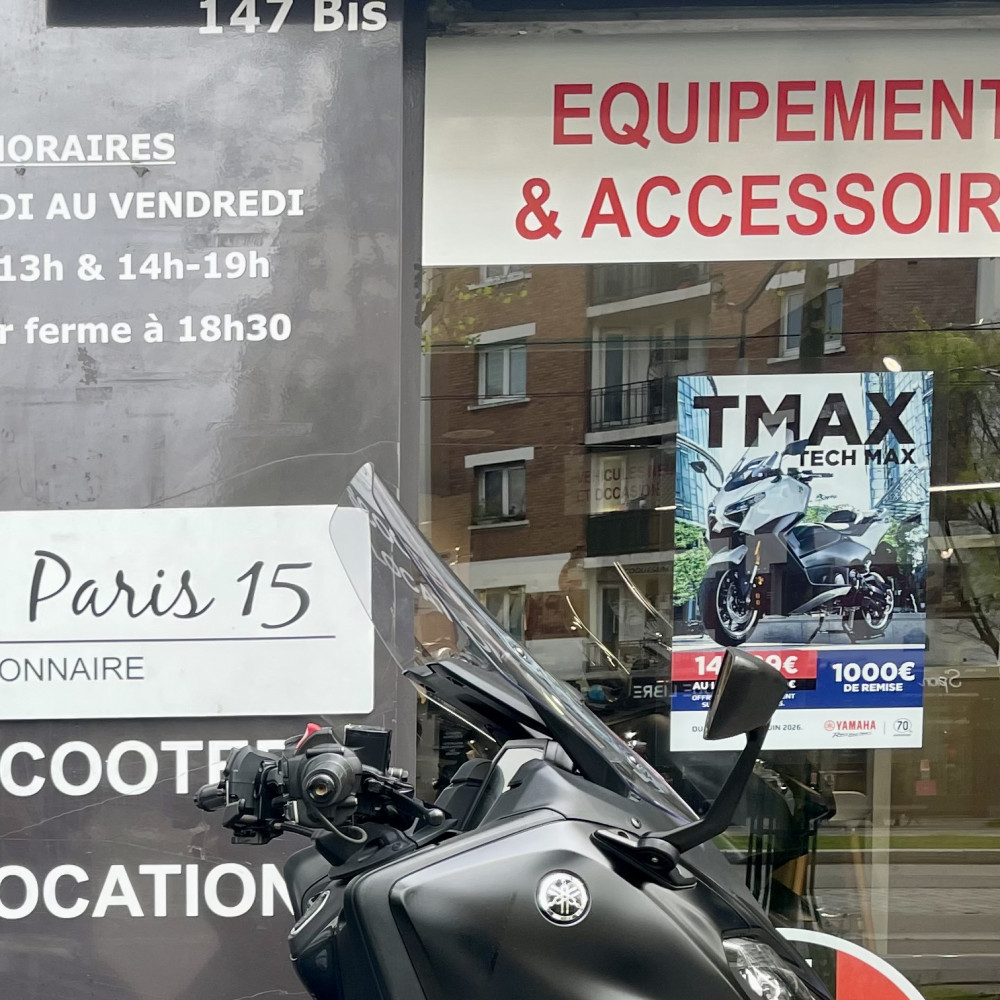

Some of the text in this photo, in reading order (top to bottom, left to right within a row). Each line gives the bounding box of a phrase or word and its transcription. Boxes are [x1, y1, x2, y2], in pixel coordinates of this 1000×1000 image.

[199, 0, 387, 33] 147 Bis
[46, 192, 97, 220] AU
[109, 189, 305, 219] VENDREDI
[515, 177, 562, 240] &
[78, 253, 106, 283] &
[117, 250, 271, 281] 14h-19h
[25, 315, 132, 345] ferme
[144, 315, 165, 343] à
[178, 313, 292, 342] 18h30
[693, 392, 916, 448] TMAX
[799, 448, 916, 466] TECH MAX
[28, 550, 216, 623] Paris
[235, 561, 313, 630] 15
[832, 661, 916, 683] 1000€
[843, 683, 904, 693] DE REMISE
[836, 720, 877, 731] YAMAHA
[896, 720, 909, 731] 70
